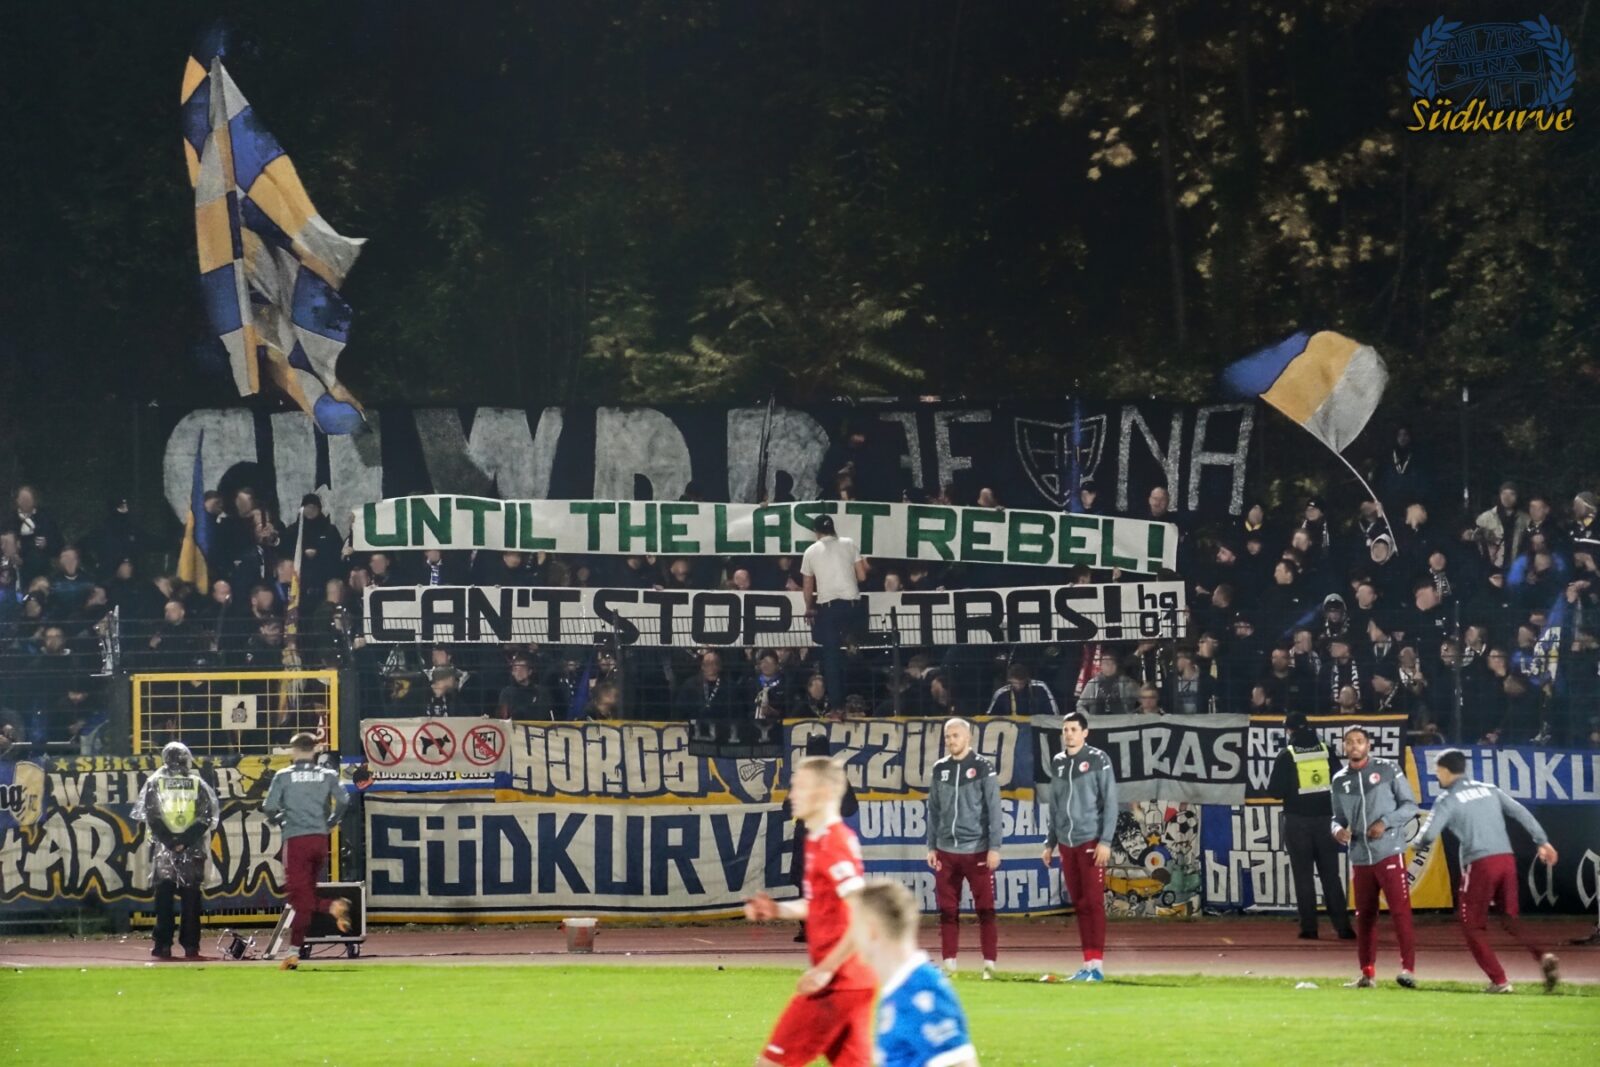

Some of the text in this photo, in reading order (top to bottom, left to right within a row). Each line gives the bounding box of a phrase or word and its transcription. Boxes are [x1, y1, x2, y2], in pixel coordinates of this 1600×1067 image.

[363, 496, 1166, 573] UNTIL THE LAST REBEL!
[369, 587, 581, 642] CAN'T
[592, 588, 793, 646] STOP
[76, 756, 203, 772] SEKTIN
[1039, 729, 1242, 782] UTRAS
